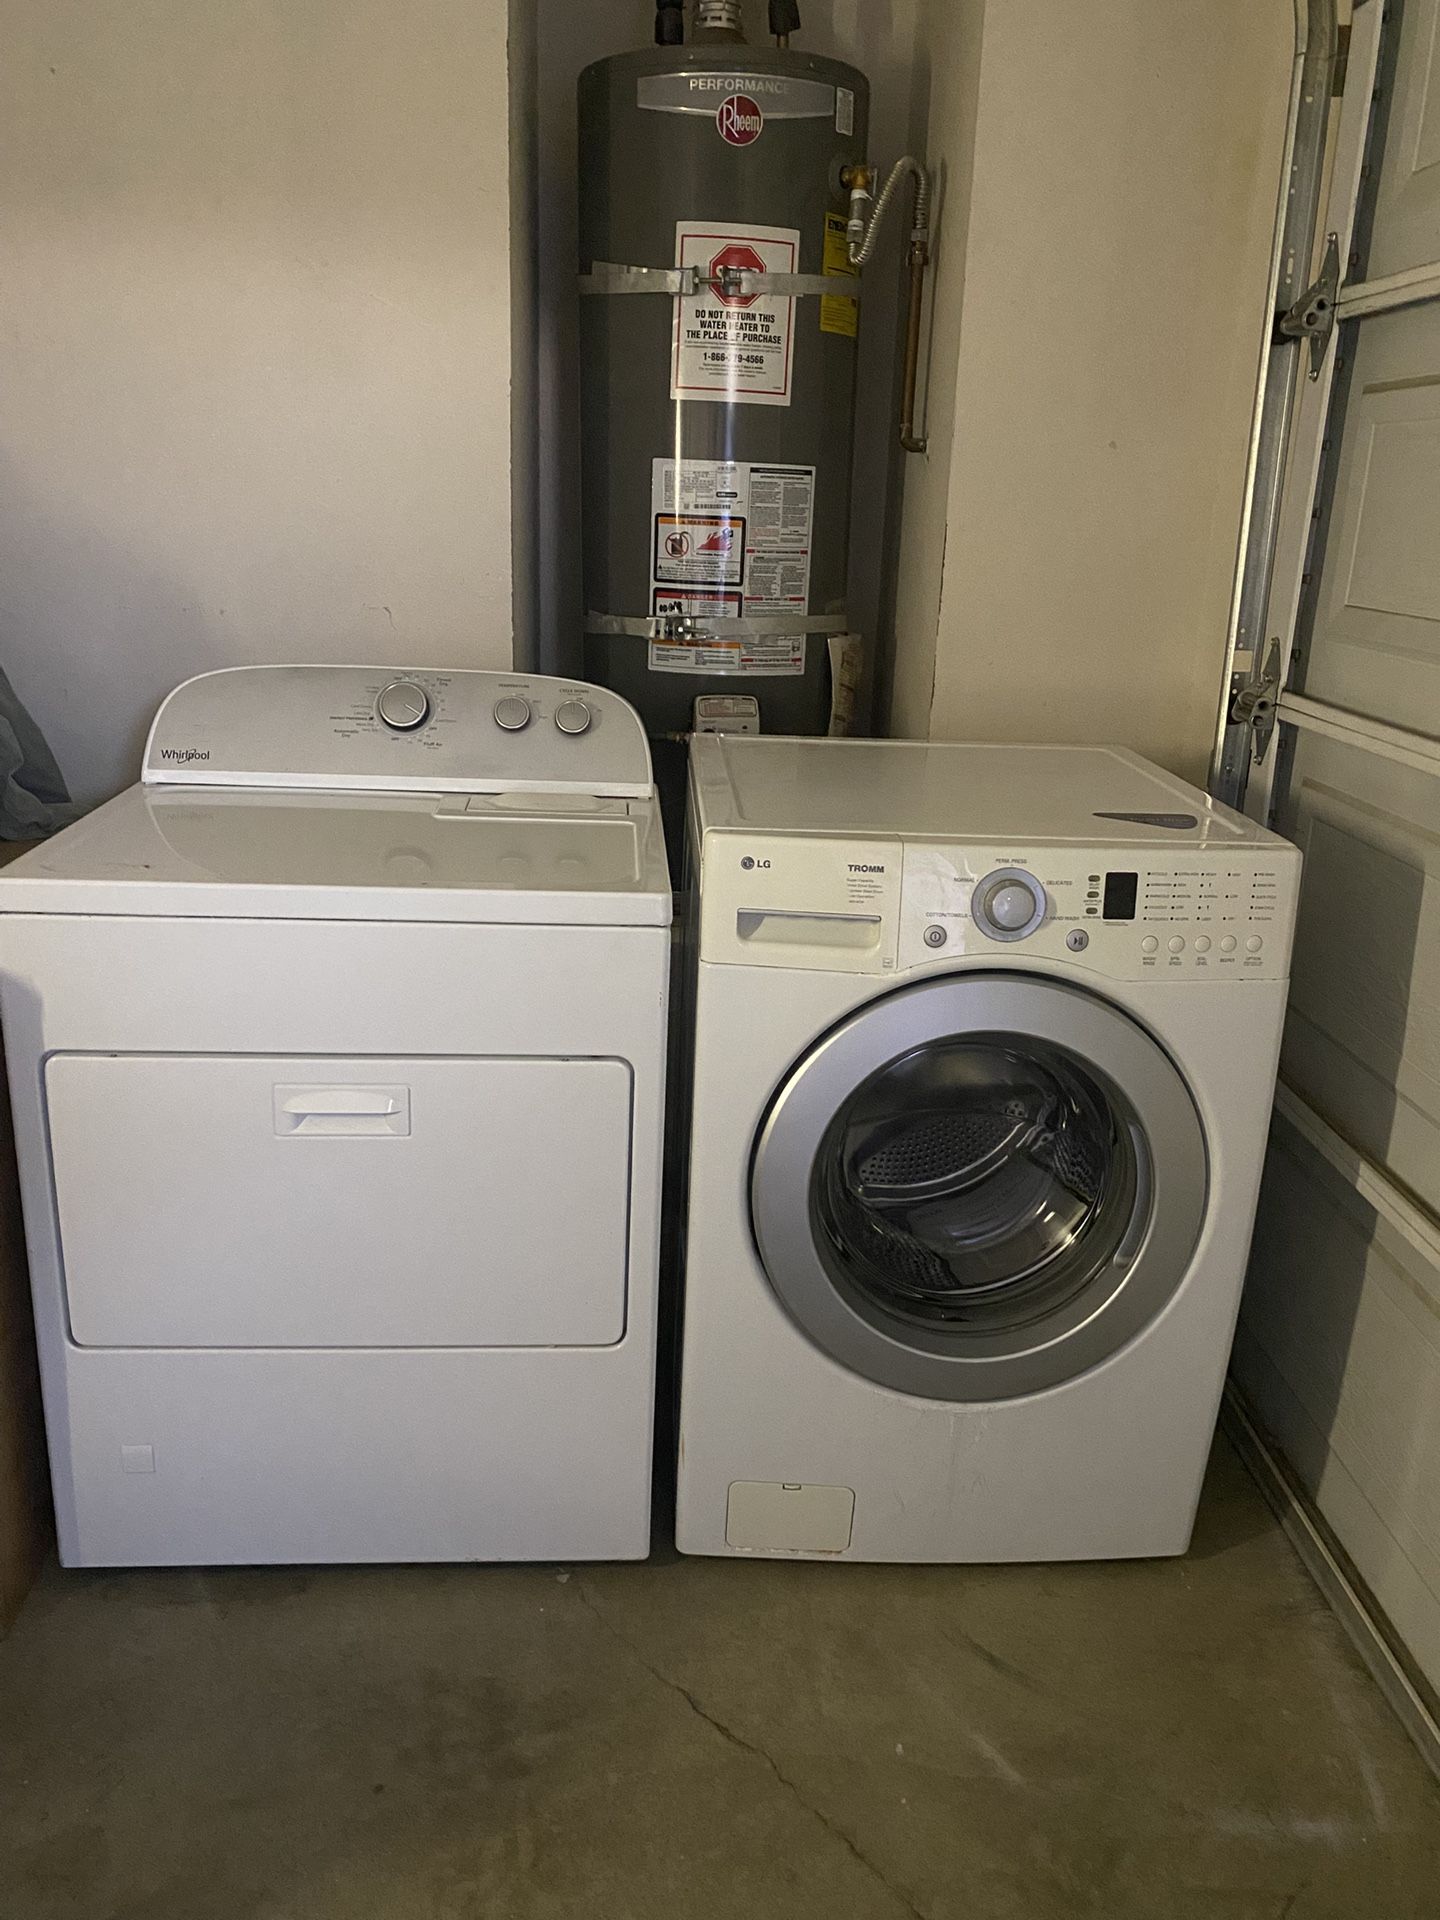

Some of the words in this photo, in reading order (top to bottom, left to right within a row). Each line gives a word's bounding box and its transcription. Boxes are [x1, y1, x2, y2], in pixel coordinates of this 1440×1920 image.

[689, 79, 792, 94] PERFORMANCE
[722, 96, 760, 138] Rheem
[695, 309, 706, 319] DO
[708, 310, 724, 320] NOT
[725, 311, 757, 321] RETURN
[758, 313, 776, 323] THIS
[700, 320, 727, 329] WATER
[760, 324, 770, 333] TO
[686, 330, 701, 339] THE
[703, 330, 728, 340] PLACE
[730, 331, 741, 342] F
[742, 333, 782, 344] PURCHASE
[703, 352, 764, 365] 1-866-9-4566
[161, 749, 210, 763] Whirlpool
[847, 864, 885, 873] TROMM
